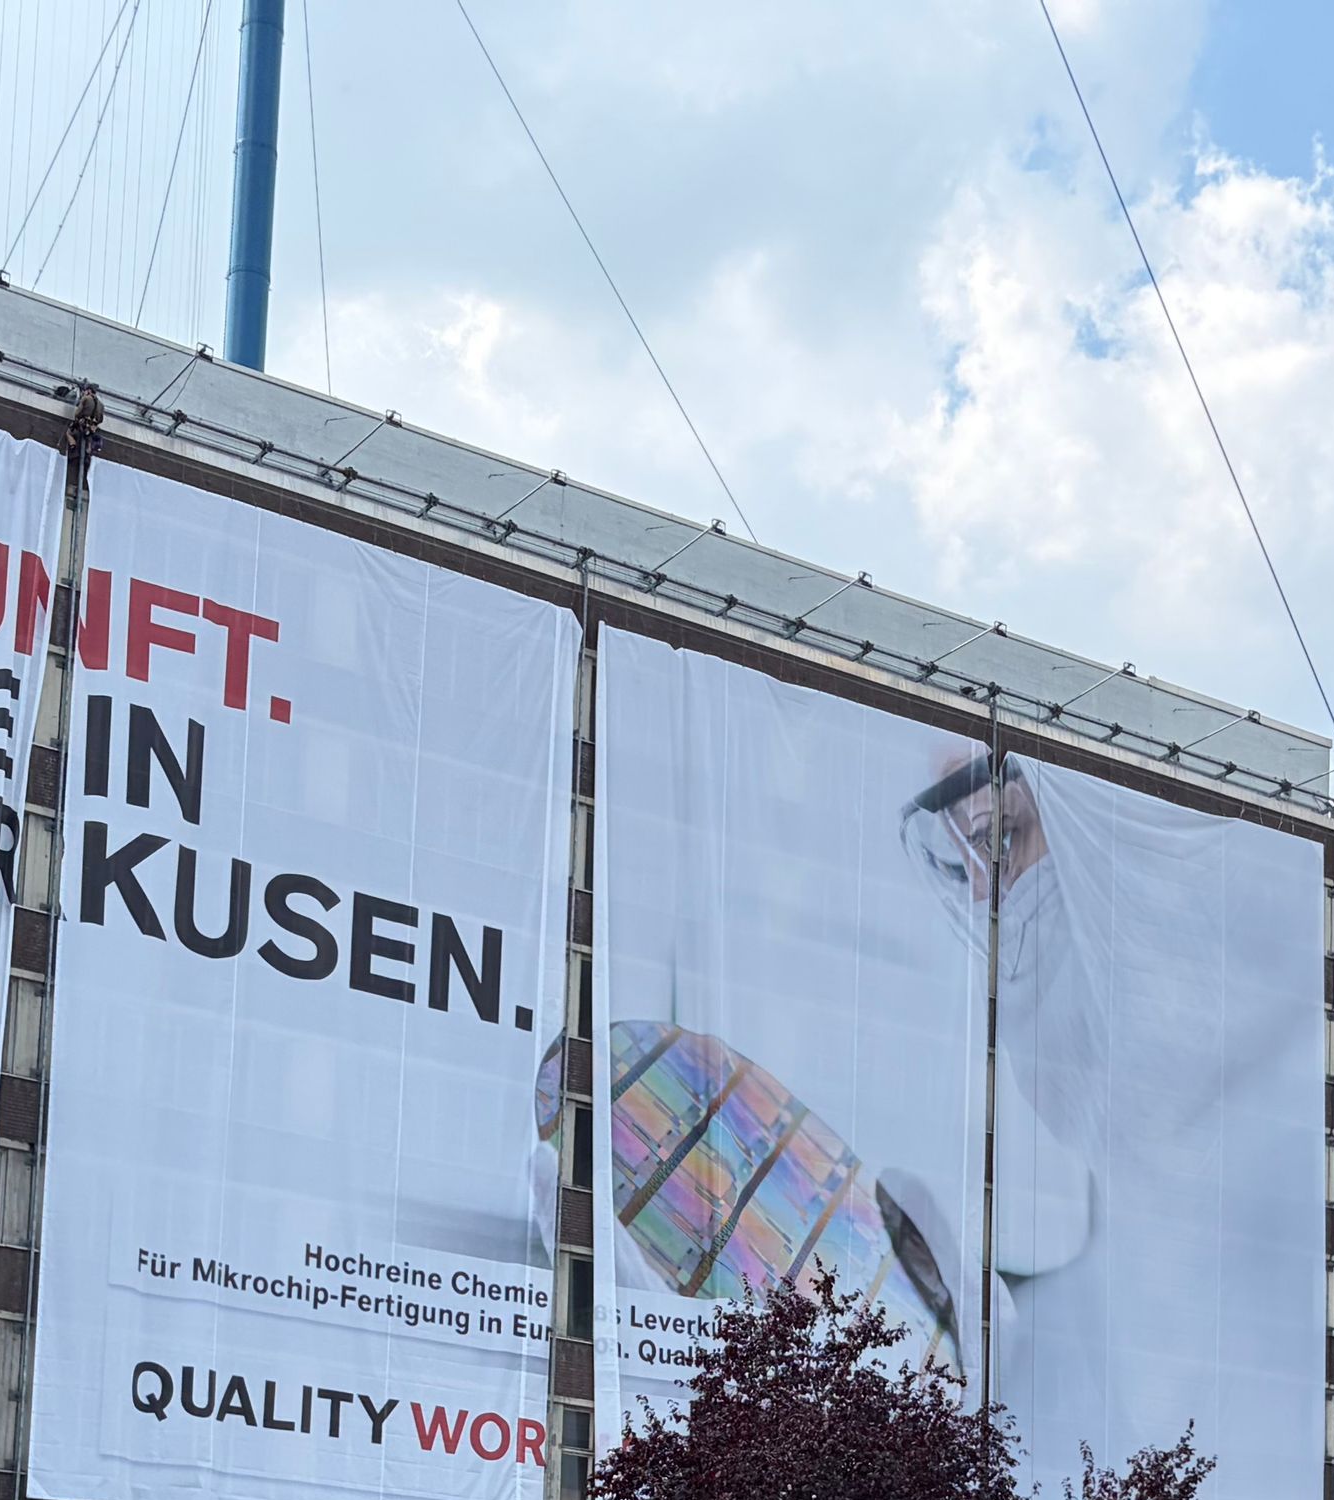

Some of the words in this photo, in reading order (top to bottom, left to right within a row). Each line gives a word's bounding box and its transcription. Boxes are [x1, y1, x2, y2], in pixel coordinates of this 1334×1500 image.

[85, 695, 205, 825] IN
[138, 1248, 181, 1280] Für
[192, 1257, 470, 1335] Mikrochip-Fertigung
[479, 1310, 502, 1335] in
[304, 1243, 442, 1291] Hochreine
[451, 1271, 549, 1308] Chemie
[132, 1361, 400, 1445] QUALITY
[410, 1402, 546, 1469] WOR
